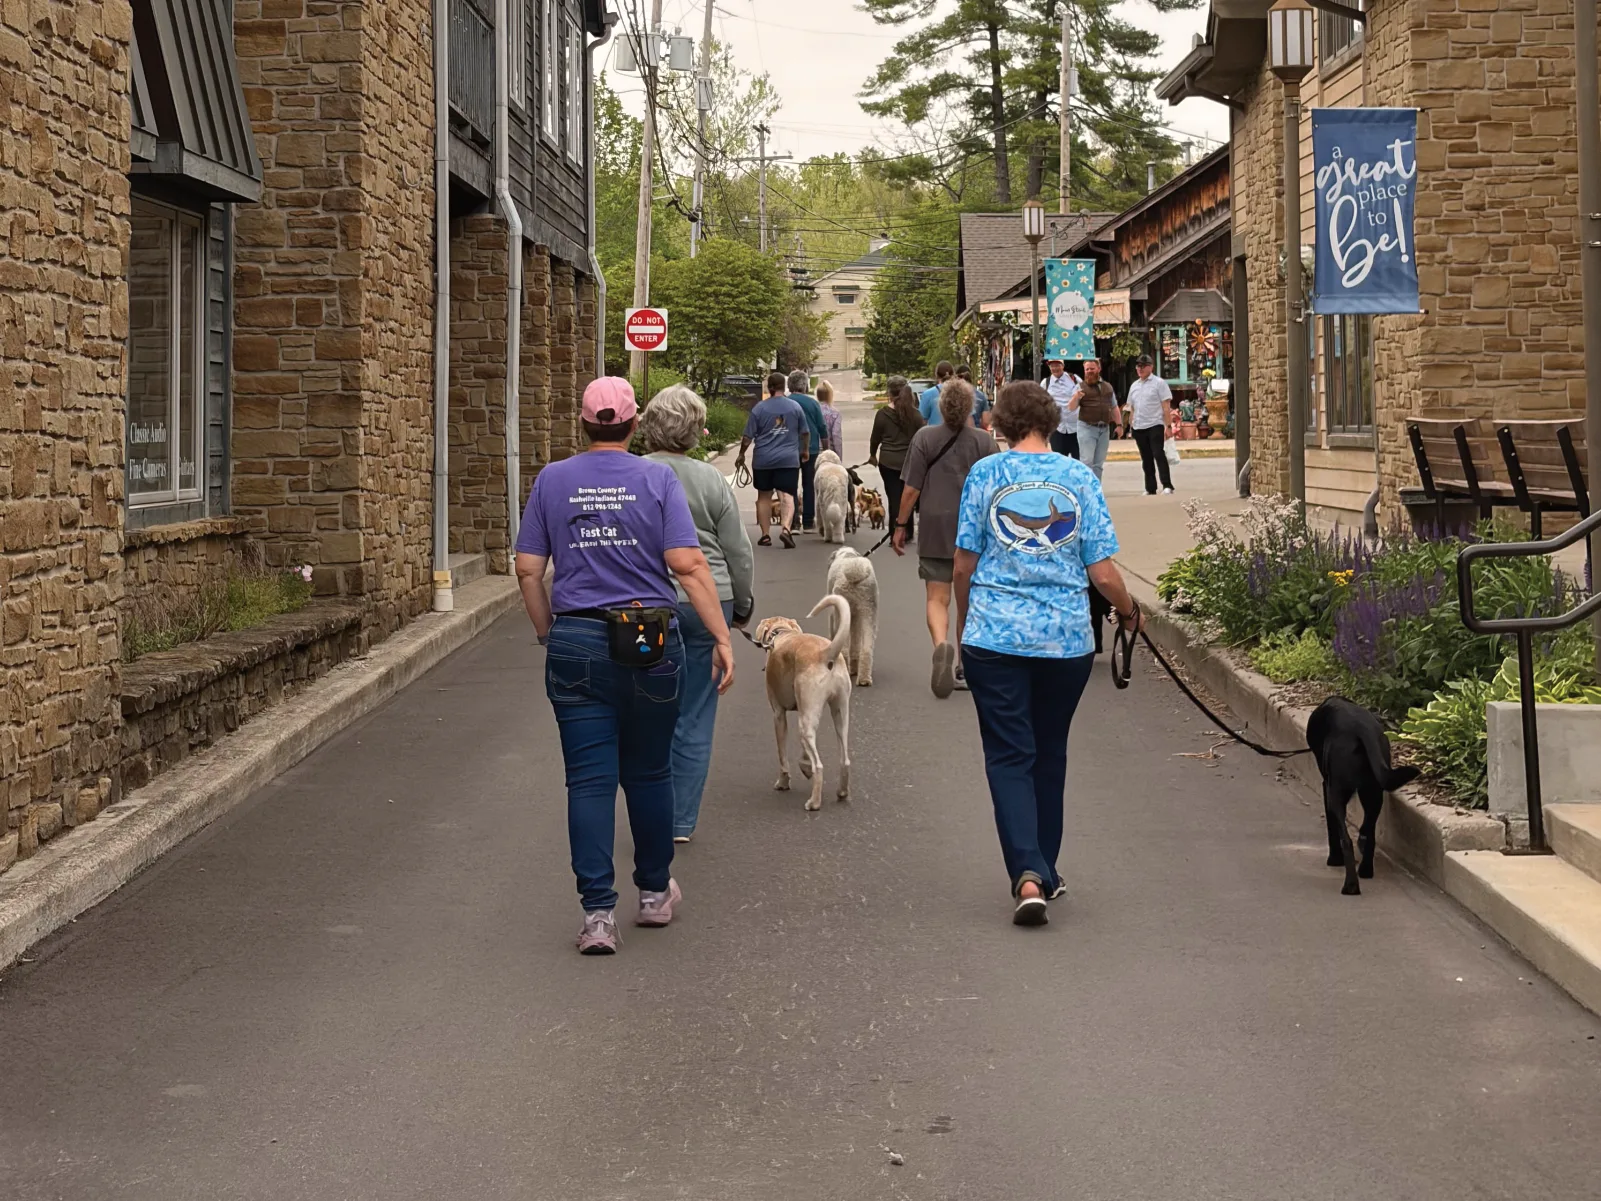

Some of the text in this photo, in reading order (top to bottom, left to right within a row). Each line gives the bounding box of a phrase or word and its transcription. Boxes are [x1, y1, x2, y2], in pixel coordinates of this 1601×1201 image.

[1332, 146, 1343, 159] a
[1316, 138, 1416, 203] great
[1357, 183, 1408, 209] place
[1367, 211, 1387, 227] to
[130, 421, 167, 444] Classic Audio
[129, 458, 142, 480] Fine
[142, 457, 167, 479] Cameras
[597, 486, 617, 494] County
[580, 526, 618, 538] Fast Cat
